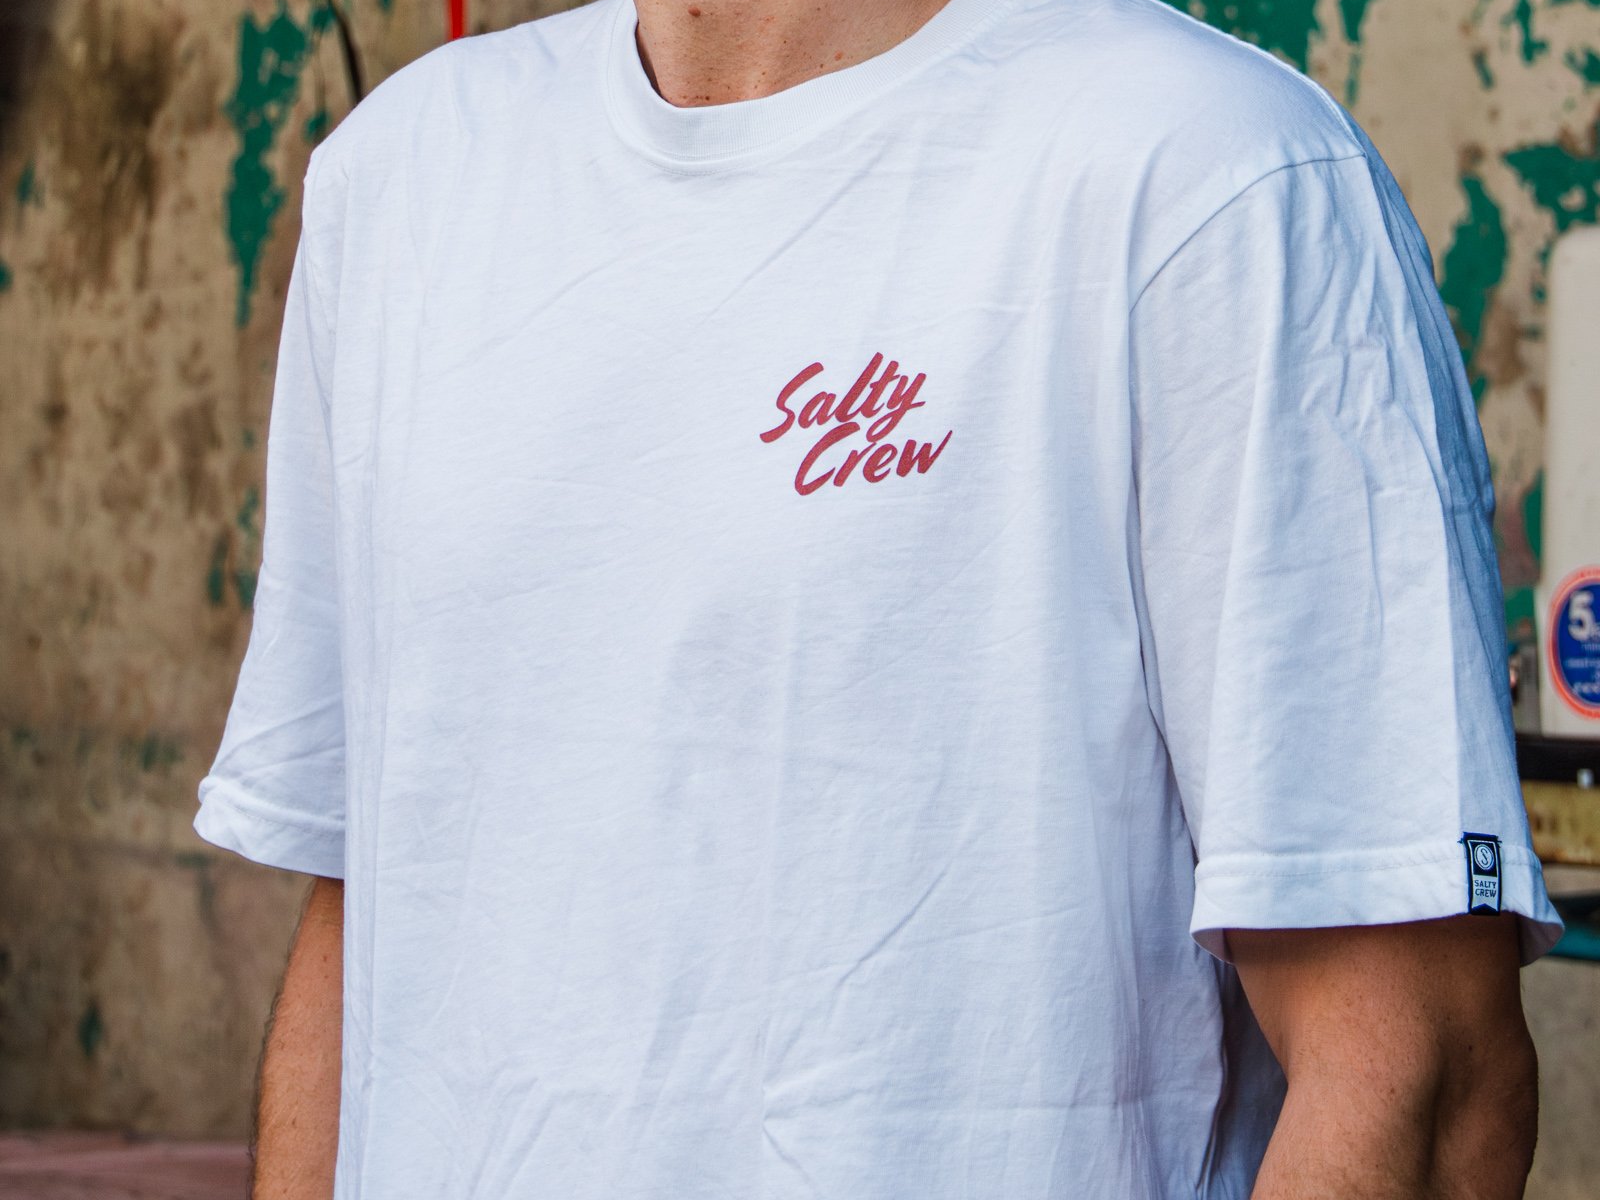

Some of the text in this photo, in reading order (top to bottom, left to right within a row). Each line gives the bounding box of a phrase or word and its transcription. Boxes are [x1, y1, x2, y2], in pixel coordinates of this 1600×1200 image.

[759, 351, 927, 443] Salty
[794, 421, 953, 496] Crew
[1474, 879, 1497, 889] SALTY
[1474, 888, 1497, 898] CREW
